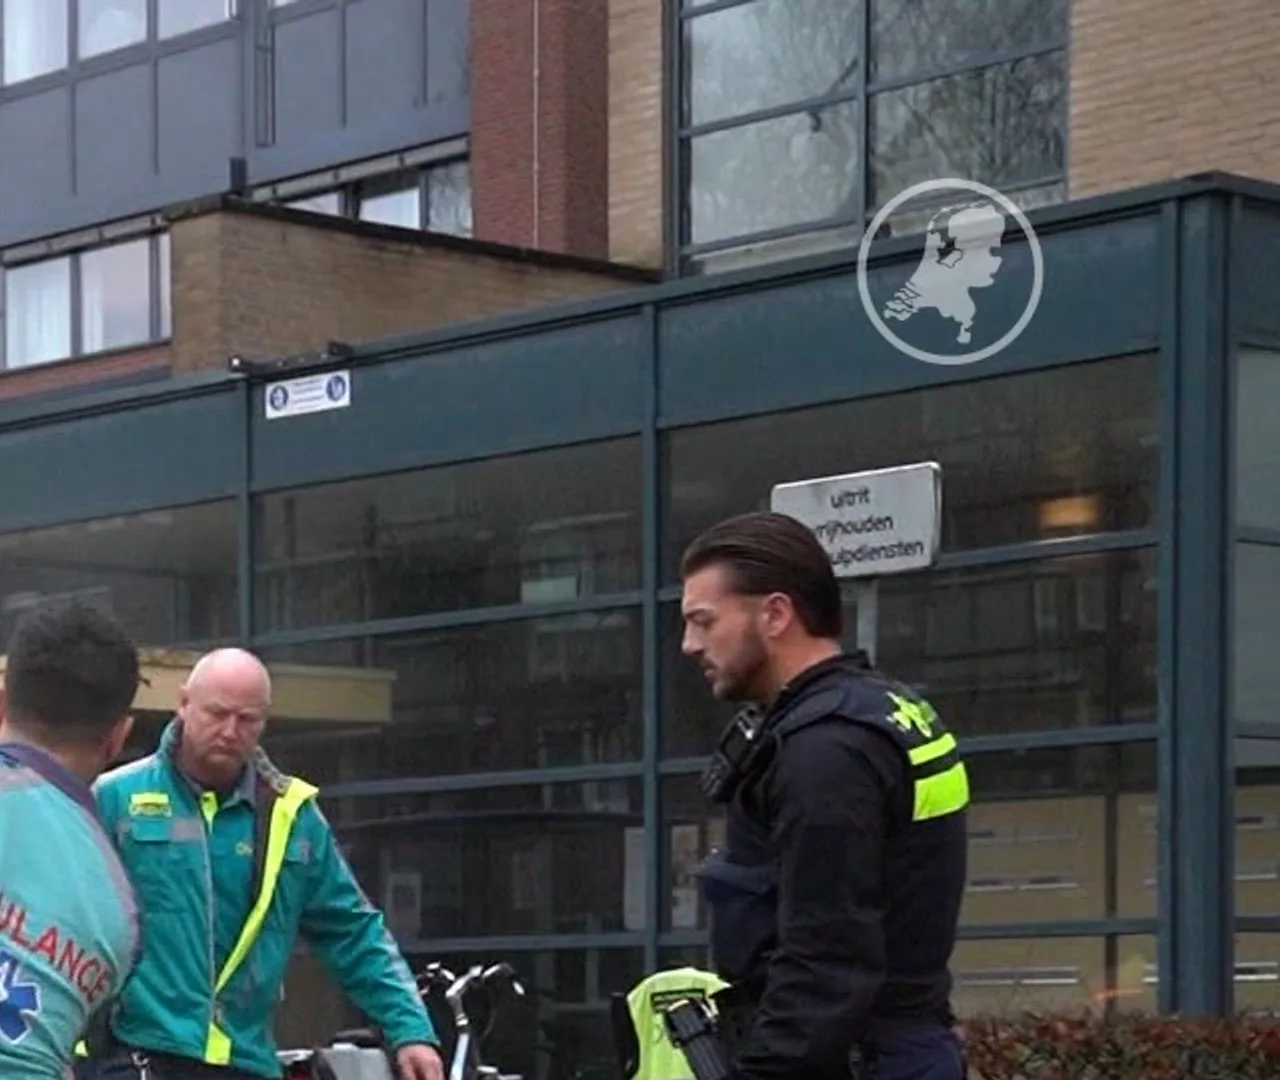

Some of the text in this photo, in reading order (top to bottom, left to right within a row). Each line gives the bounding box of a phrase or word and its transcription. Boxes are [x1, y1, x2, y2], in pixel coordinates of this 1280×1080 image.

[830, 486, 871, 509] uitrit
[815, 514, 894, 545] rijhouden
[829, 540, 925, 568] ulpdiensten
